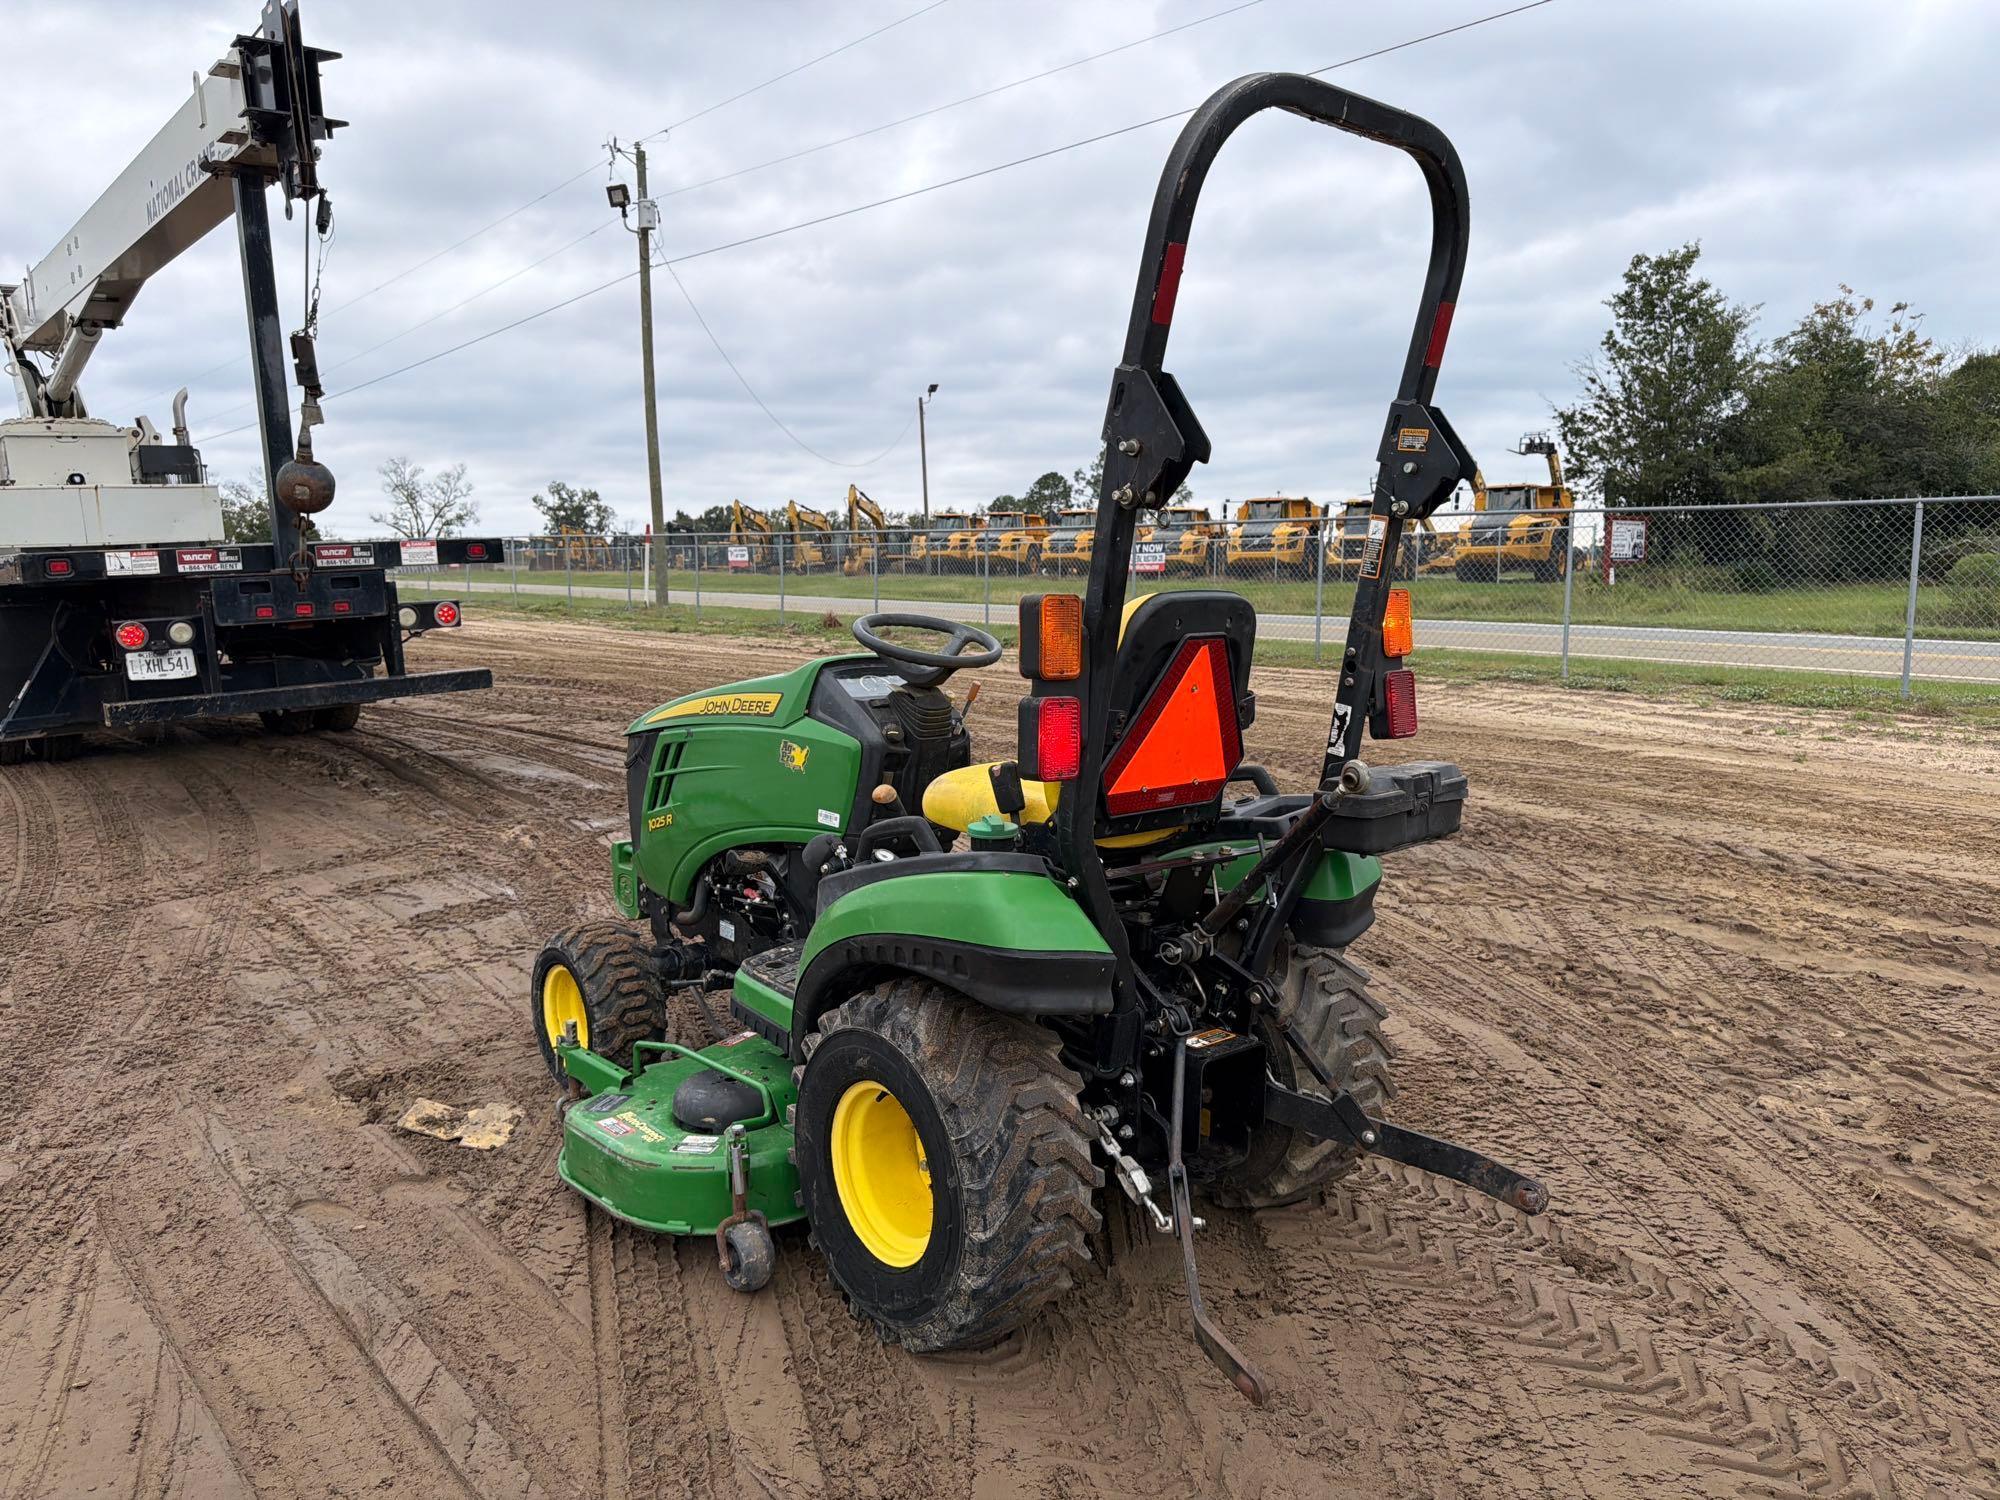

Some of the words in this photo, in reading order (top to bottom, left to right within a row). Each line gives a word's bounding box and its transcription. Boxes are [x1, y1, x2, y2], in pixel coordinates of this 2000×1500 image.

[146, 171, 185, 225] NATIONAL
[1142, 543, 1164, 553] NOW
[181, 553, 212, 562] YANCEY
[145, 656, 189, 673] XHL541
[700, 699, 731, 713] JOHN
[732, 698, 771, 712] DEERE
